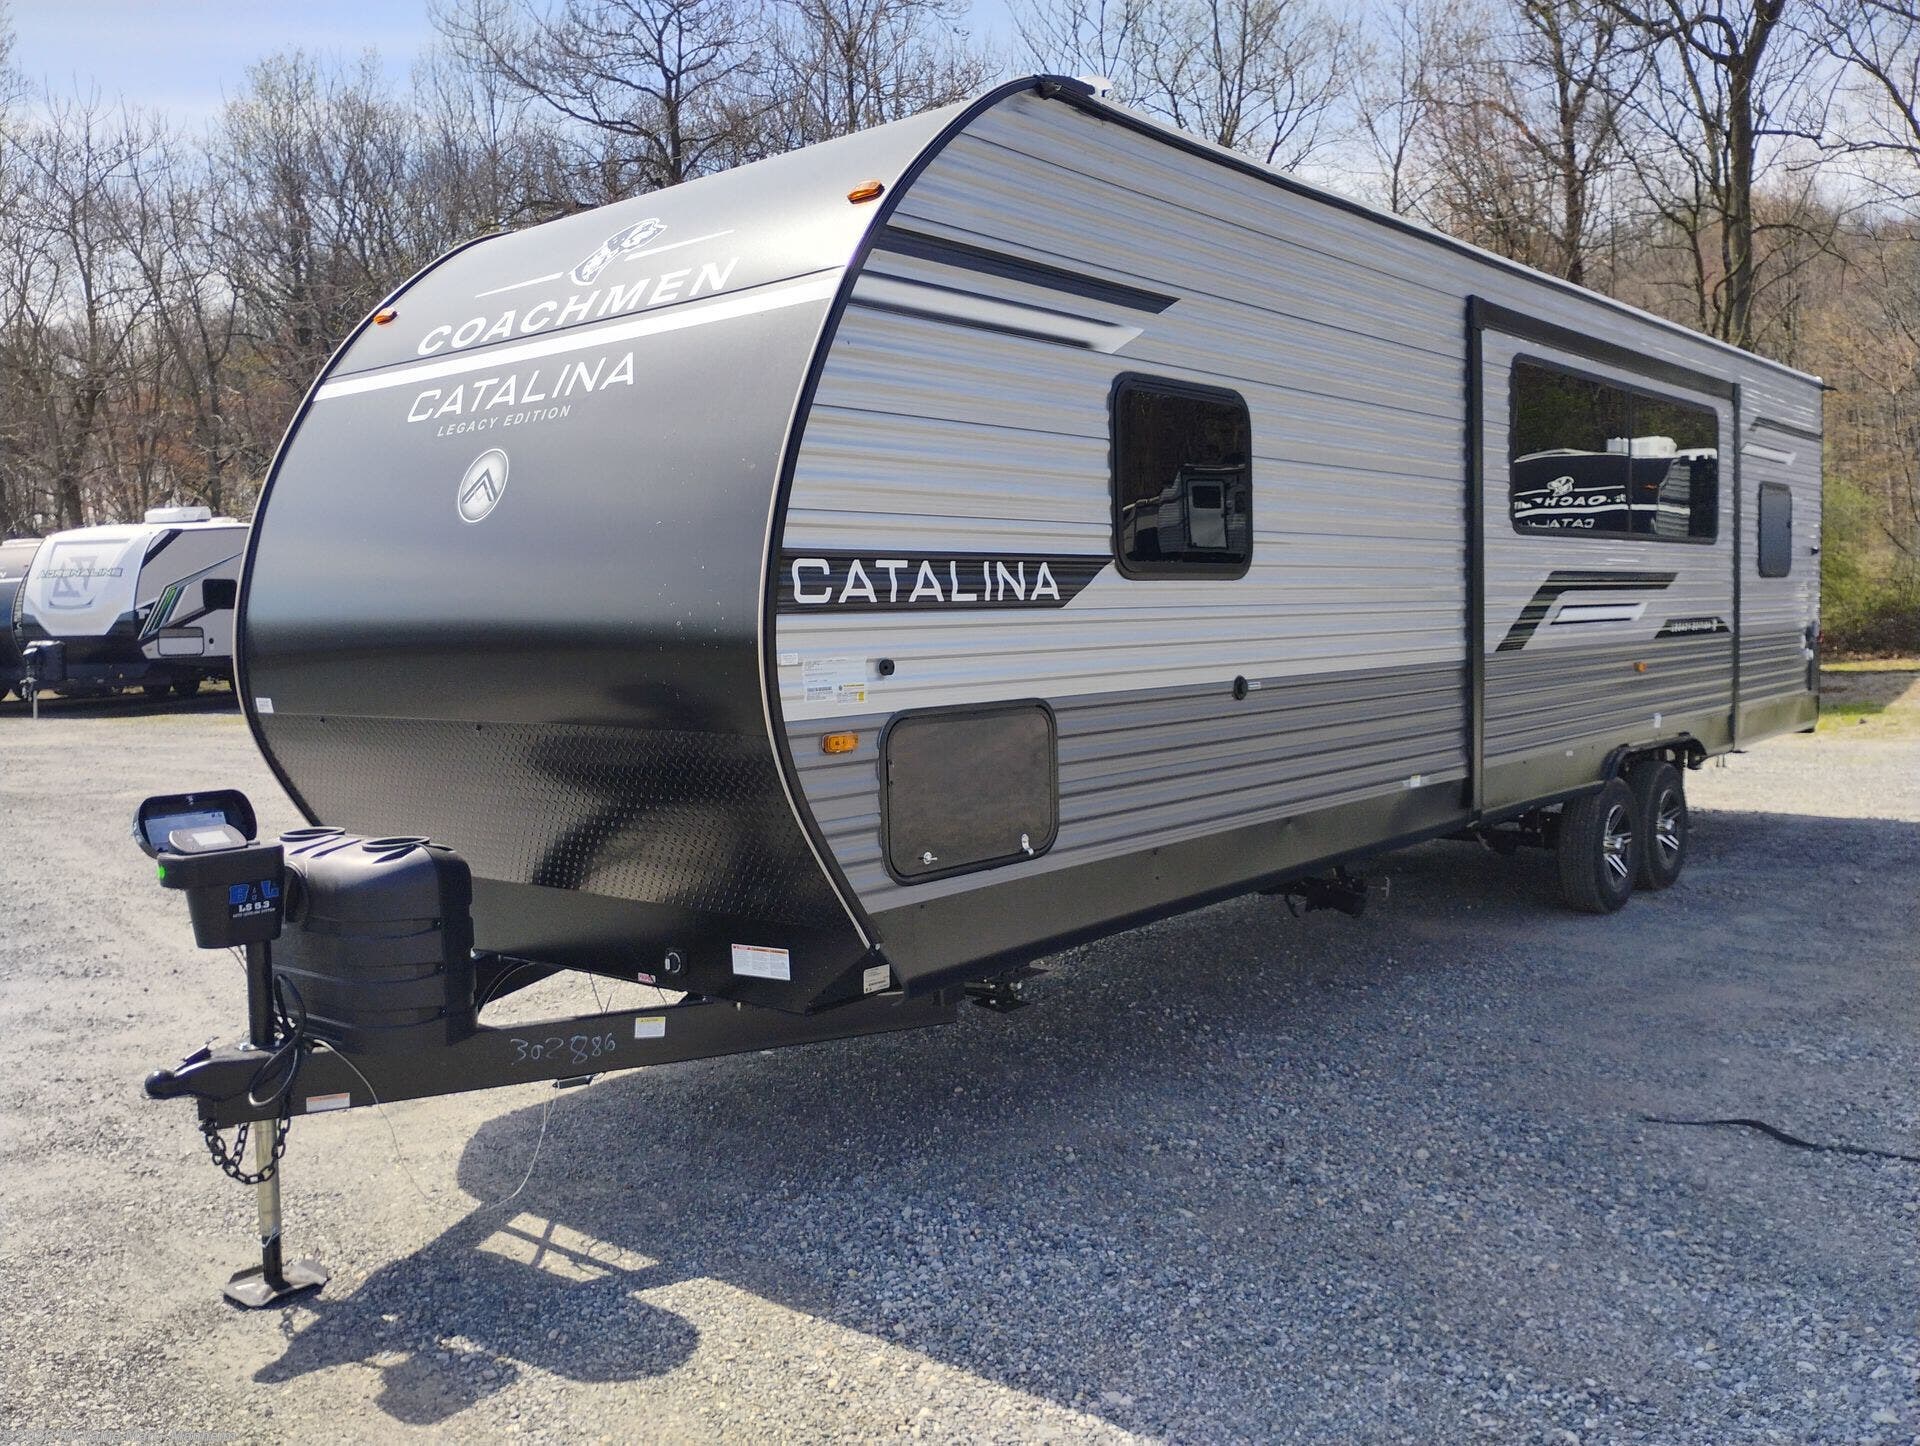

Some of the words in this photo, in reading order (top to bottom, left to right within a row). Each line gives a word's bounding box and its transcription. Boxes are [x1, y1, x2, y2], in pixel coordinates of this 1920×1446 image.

[417, 257, 740, 356] COACHMEN
[406, 352, 636, 423] CATALINA
[436, 416, 500, 437] LEGACY
[504, 404, 571, 427] EDITION
[791, 558, 1060, 604] CATALINA
